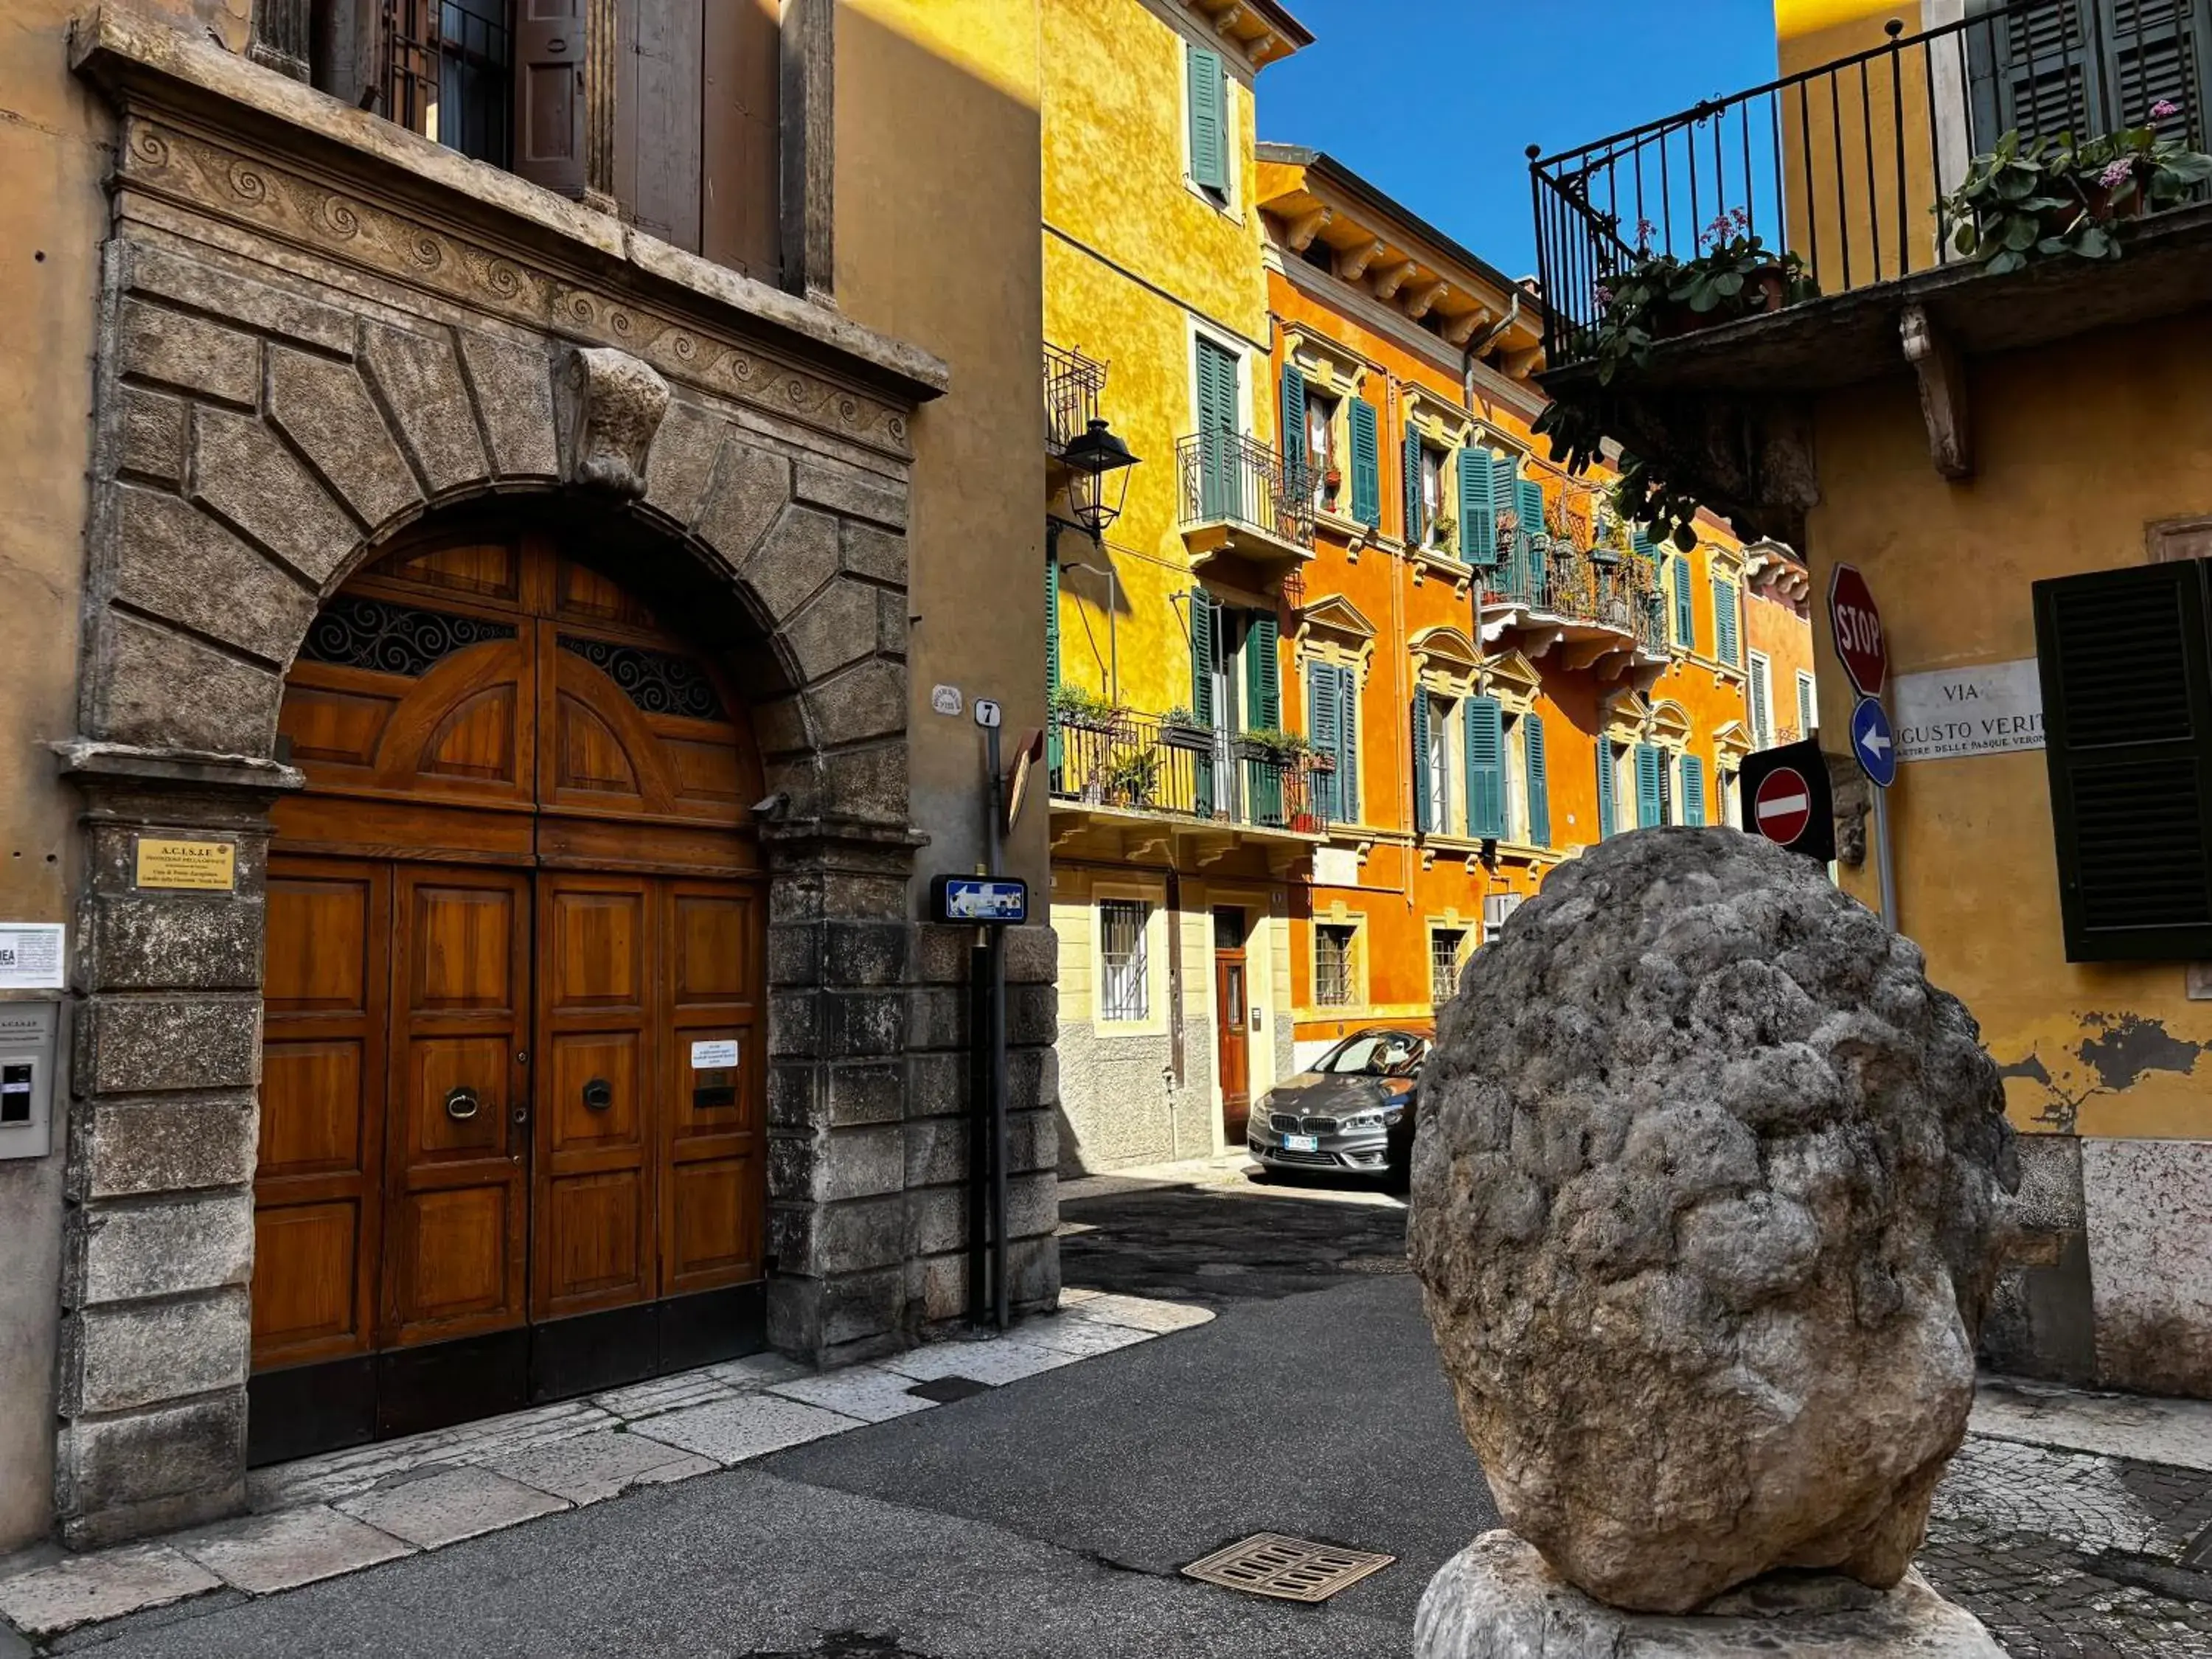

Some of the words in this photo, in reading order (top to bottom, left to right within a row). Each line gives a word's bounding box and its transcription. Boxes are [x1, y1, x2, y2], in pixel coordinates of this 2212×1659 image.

[1837, 604, 1879, 658] STOP
[1944, 684, 1979, 701] VIA
[984, 704, 993, 723] 7
[1892, 722, 1972, 747] UGUSTO
[1896, 746, 1931, 757] ARTIRE
[1935, 742, 1967, 753] DELLE
[1971, 737, 2009, 751] PASQUE
